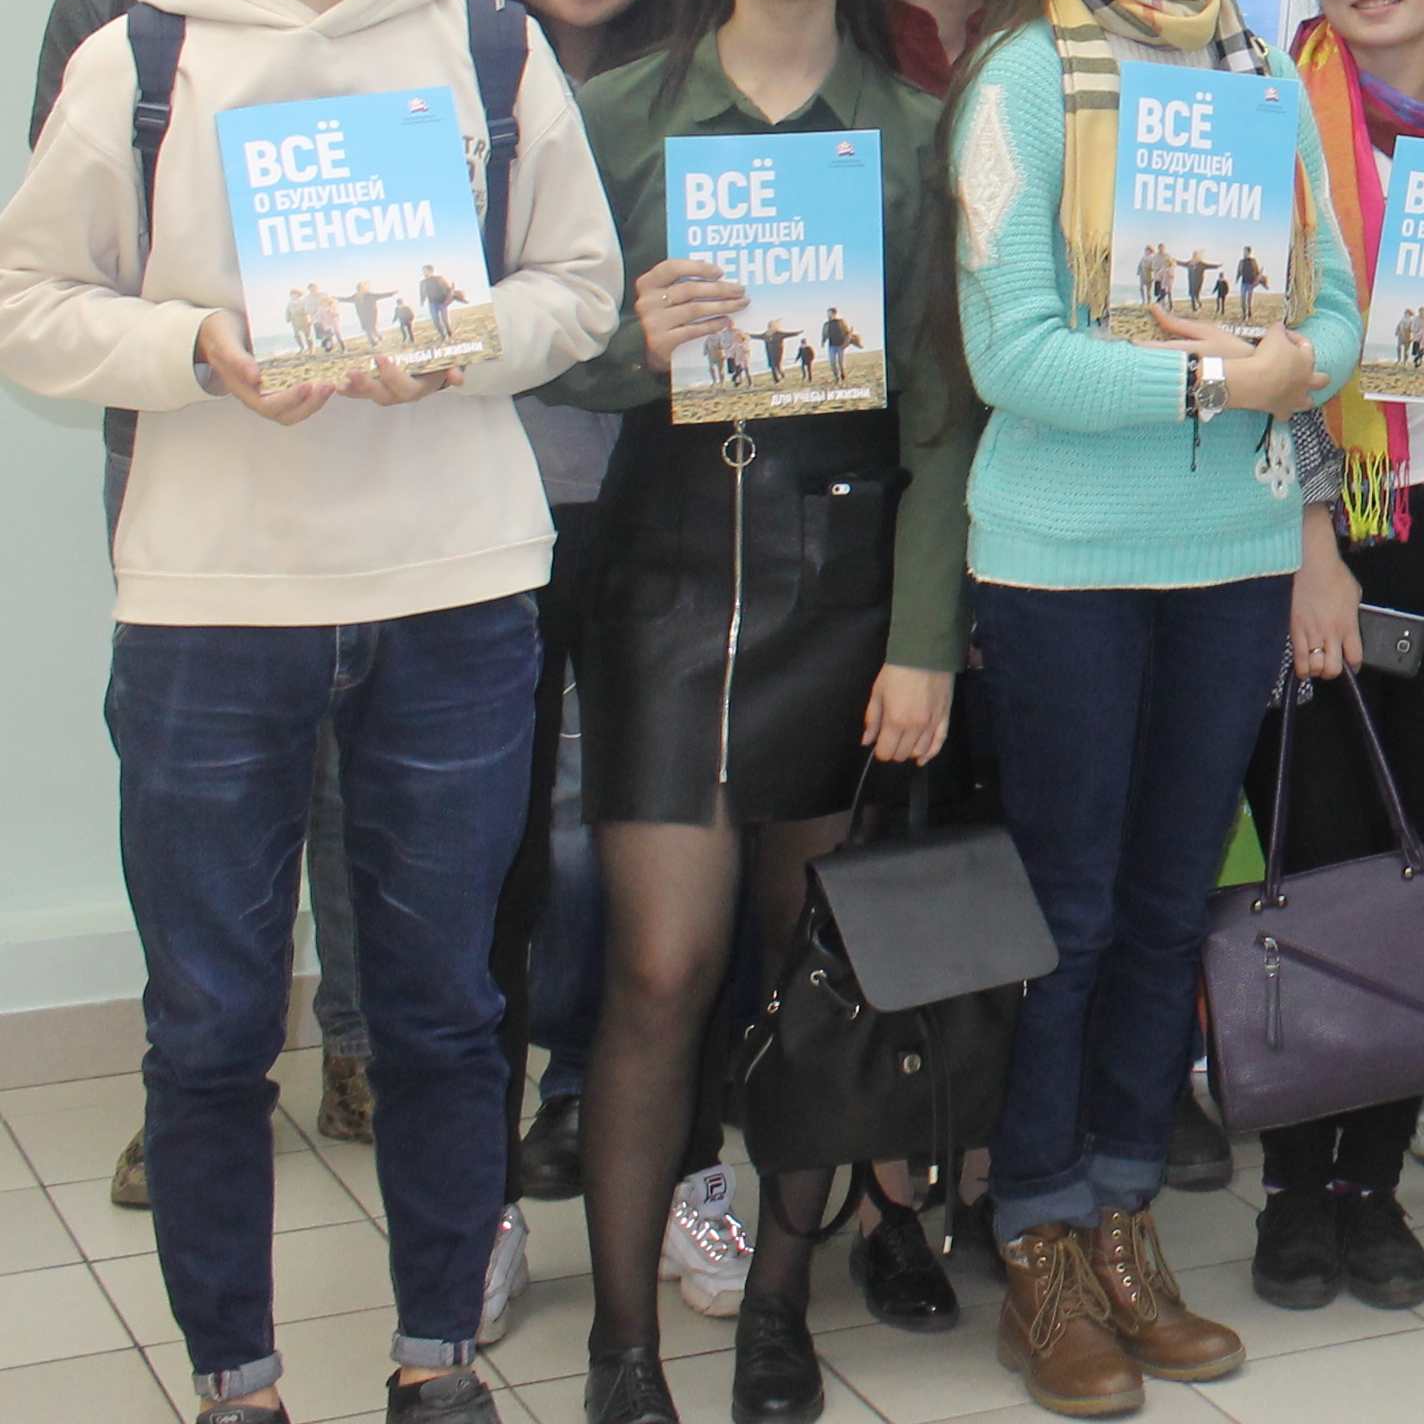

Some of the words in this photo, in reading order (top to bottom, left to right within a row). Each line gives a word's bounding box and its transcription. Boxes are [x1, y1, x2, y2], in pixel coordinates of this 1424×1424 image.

[1137, 91, 1214, 149] ВСЁ
[244, 120, 350, 188] ВСЁ
[1136, 148, 1148, 168] О
[1152, 150, 1233, 176] БУДУЩЕЙ
[254, 193, 270, 213] О
[275, 175, 385, 211] БУДУЩЕЙ
[685, 158, 777, 220] ВСЁ
[1133, 173, 1262, 221] ПЕНСИИ
[258, 200, 435, 256] ПЕНСИИ
[687, 227, 701, 246] О
[707, 216, 805, 247] БУДУЩЕЙ
[1402, 219, 1415, 237] О
[444, 341, 484, 357] ЖИЗНИ
[771, 392, 793, 406] ДЛЯ
[835, 387, 871, 401] ЖИЗНИ
